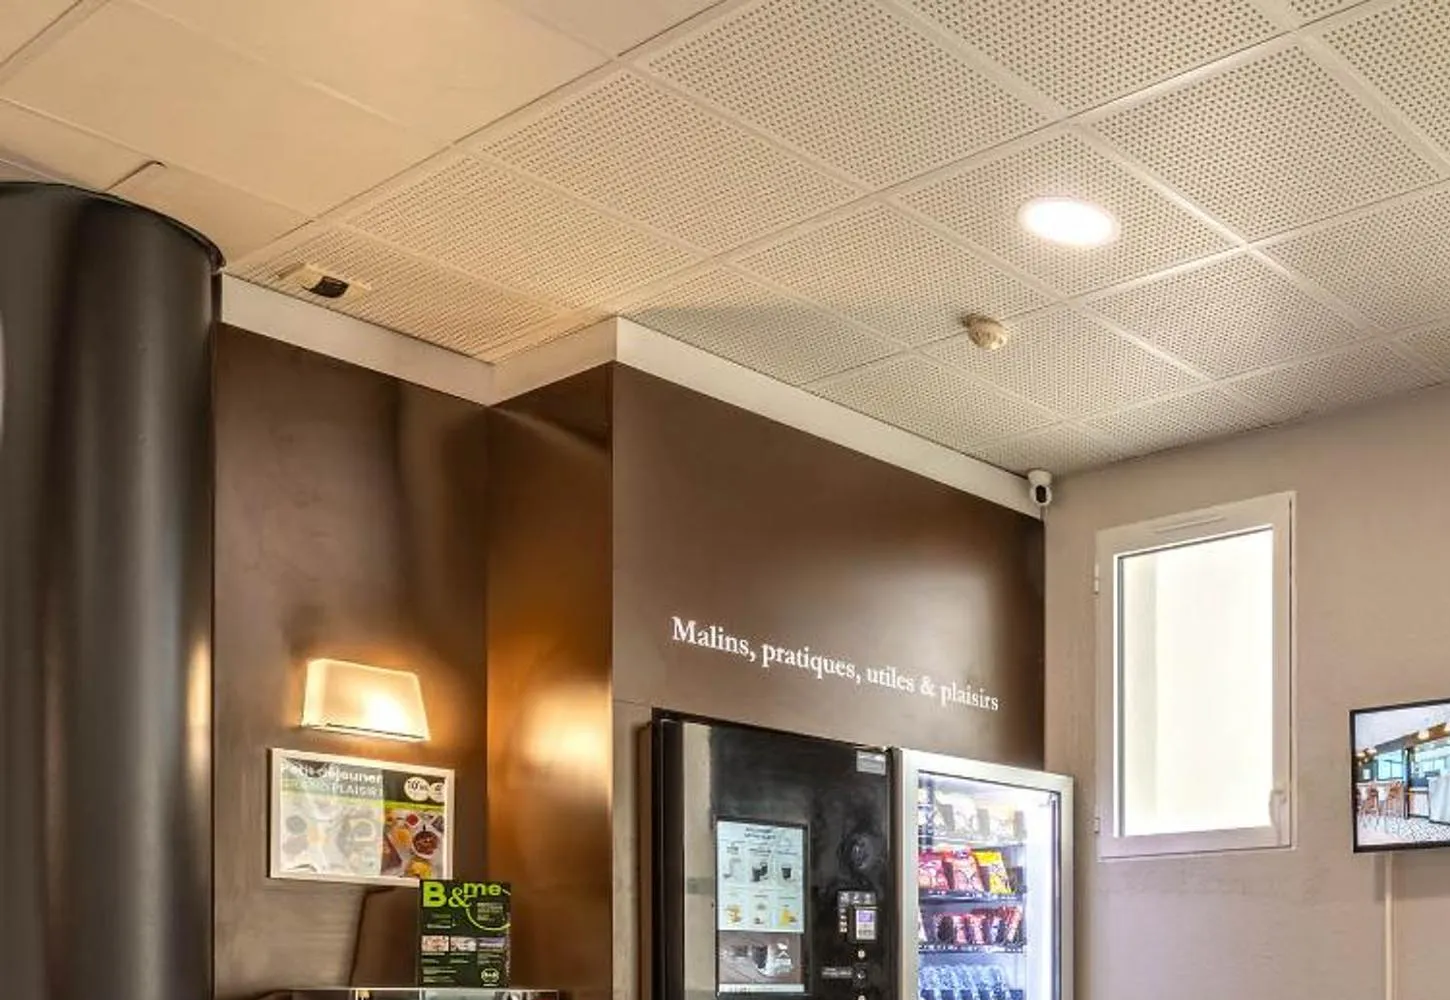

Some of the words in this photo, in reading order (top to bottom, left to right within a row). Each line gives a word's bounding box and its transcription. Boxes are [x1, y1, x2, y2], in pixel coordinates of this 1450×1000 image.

[671, 616, 756, 662] Malins,
[761, 643, 861, 685] pratiques,
[867, 665, 915, 693] utiles
[921, 675, 937, 698] &
[940, 681, 999, 712] plaisirs
